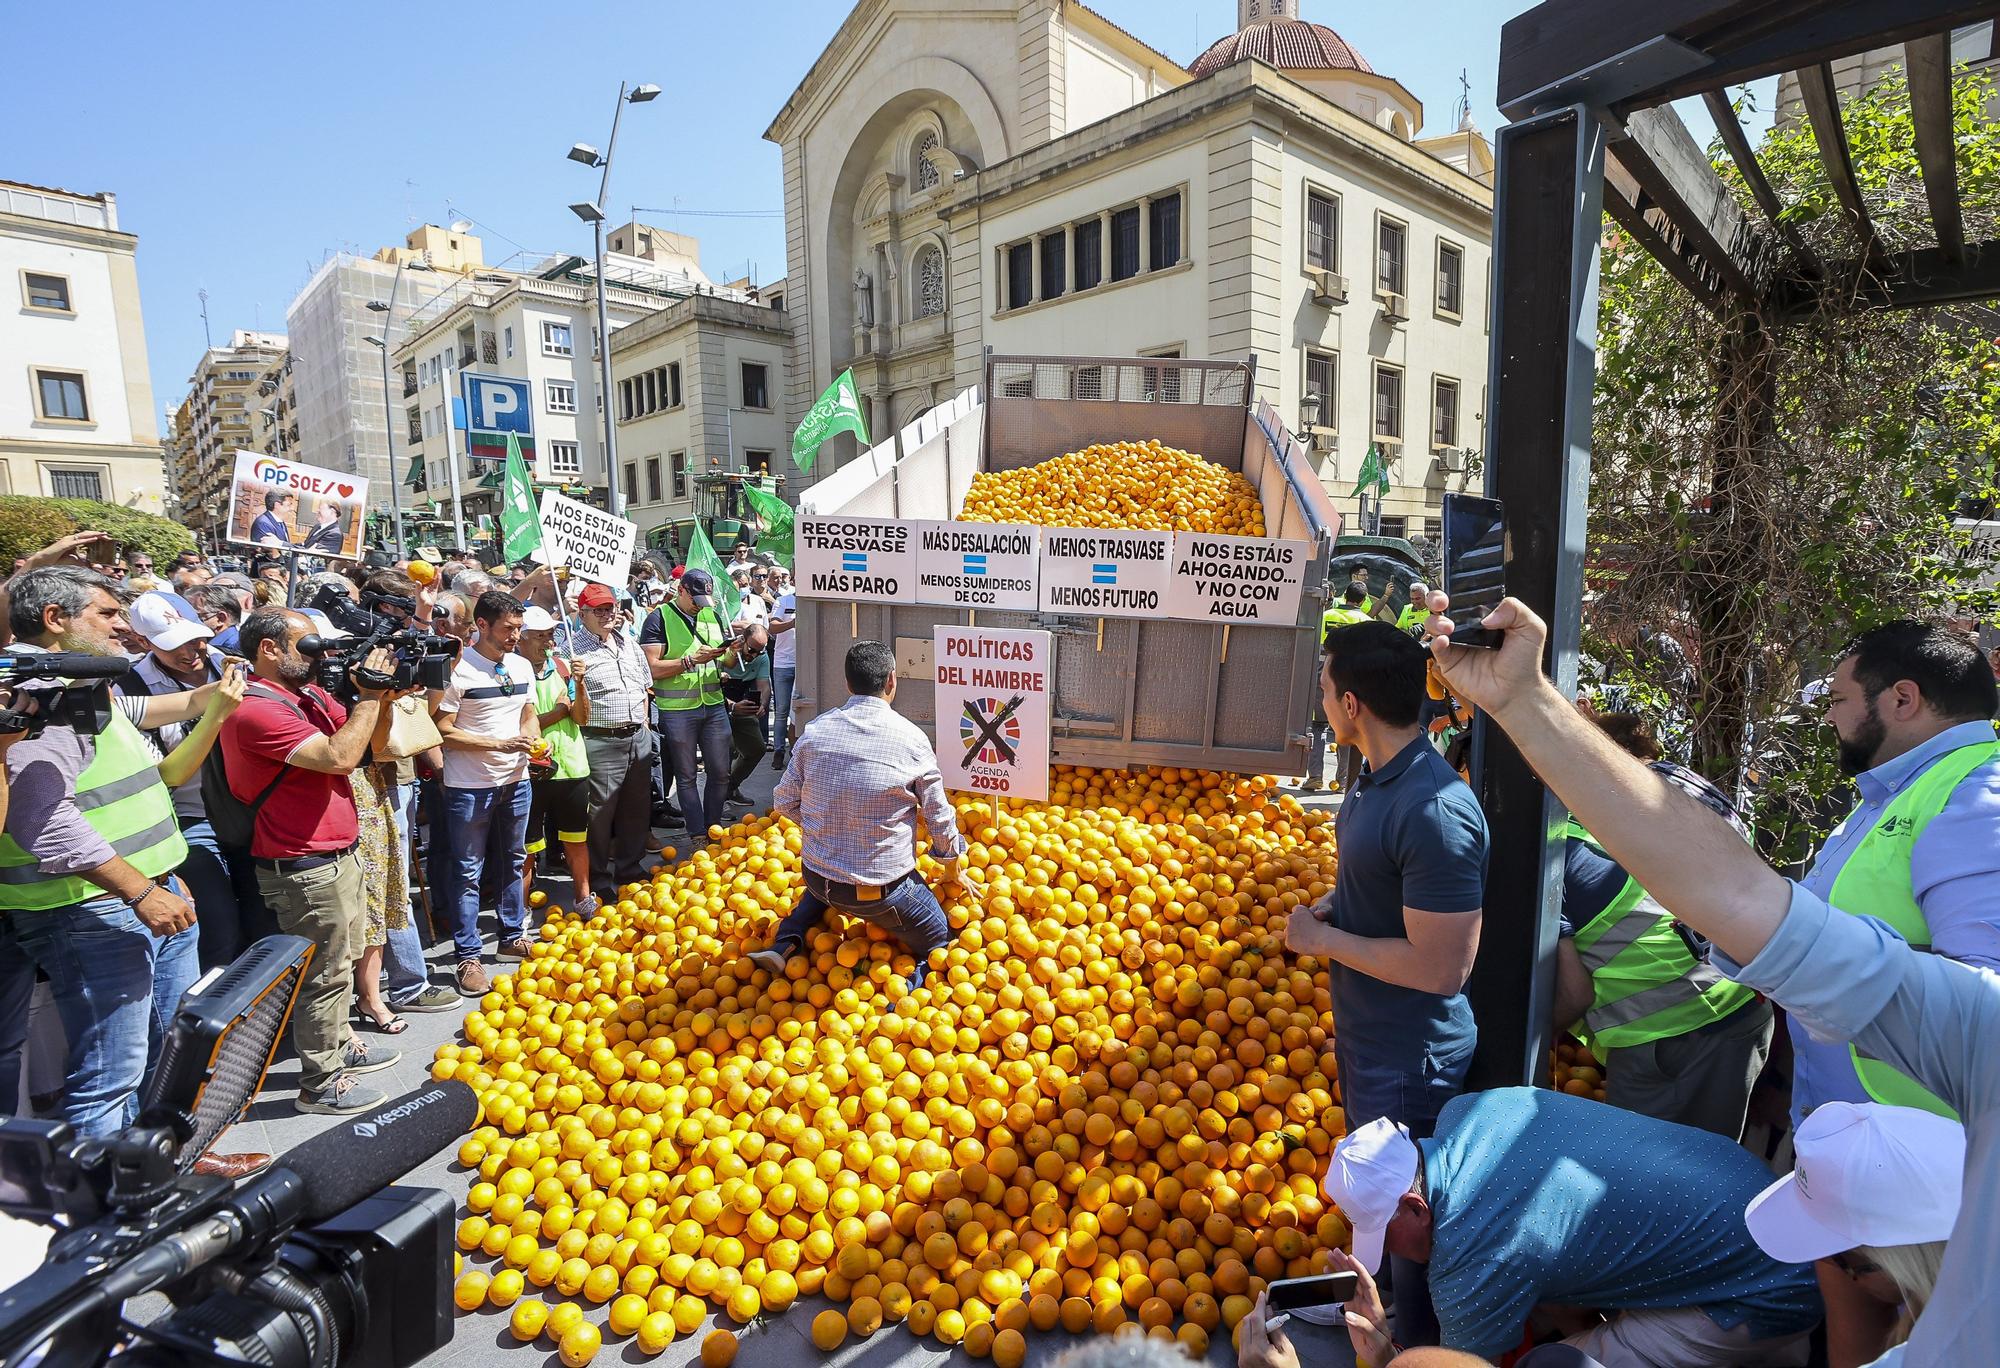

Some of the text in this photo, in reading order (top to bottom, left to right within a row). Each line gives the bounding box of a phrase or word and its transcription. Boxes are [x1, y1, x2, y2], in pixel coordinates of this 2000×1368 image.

[480, 382, 518, 427] P
[554, 501, 626, 538] NOS ESTÁIS
[802, 522, 908, 539] RECORTES
[543, 515, 627, 555] AHOGANDO...
[804, 537, 906, 553] TRASVASE
[923, 526, 1031, 555] MÁS DESALACIÓN
[556, 534, 615, 566] Y NO CON
[1049, 537, 1165, 561] MENOS TRASVASE
[1191, 541, 1293, 564] NOS ESTÁIS
[564, 555, 600, 577] AGUA
[1177, 560, 1297, 584] AHOGANDO...
[812, 569, 898, 596] MÁS PARO
[920, 574, 1031, 592] MENOS SUMIDEROS
[1195, 581, 1279, 601] Y NO CON
[955, 591, 995, 604] DE CO2
[1051, 587, 1159, 609] MENOS FUTURO
[1209, 601, 1258, 618] AGUA
[946, 635, 1034, 662] POLÍTICAS
[938, 665, 1043, 692] DEL HAMBRE
[970, 765, 1010, 778] AGENDA
[971, 775, 1010, 792] 2030
